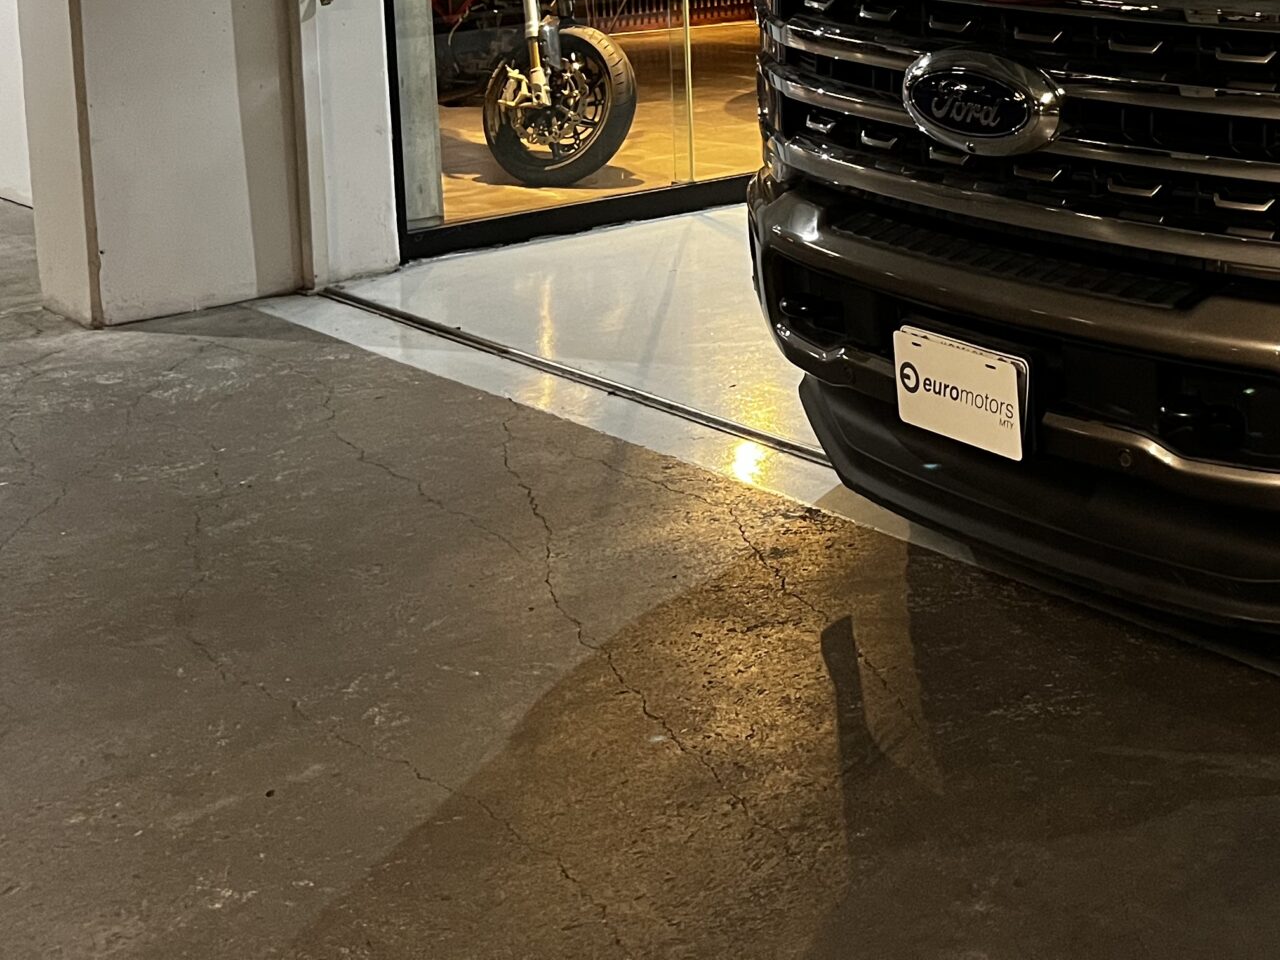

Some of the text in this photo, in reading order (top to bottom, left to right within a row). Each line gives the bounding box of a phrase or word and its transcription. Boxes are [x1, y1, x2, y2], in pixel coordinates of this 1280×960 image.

[931, 79, 1001, 127] Ford
[922, 377, 1014, 418] euromotors
[999, 419, 1014, 430] MTY
